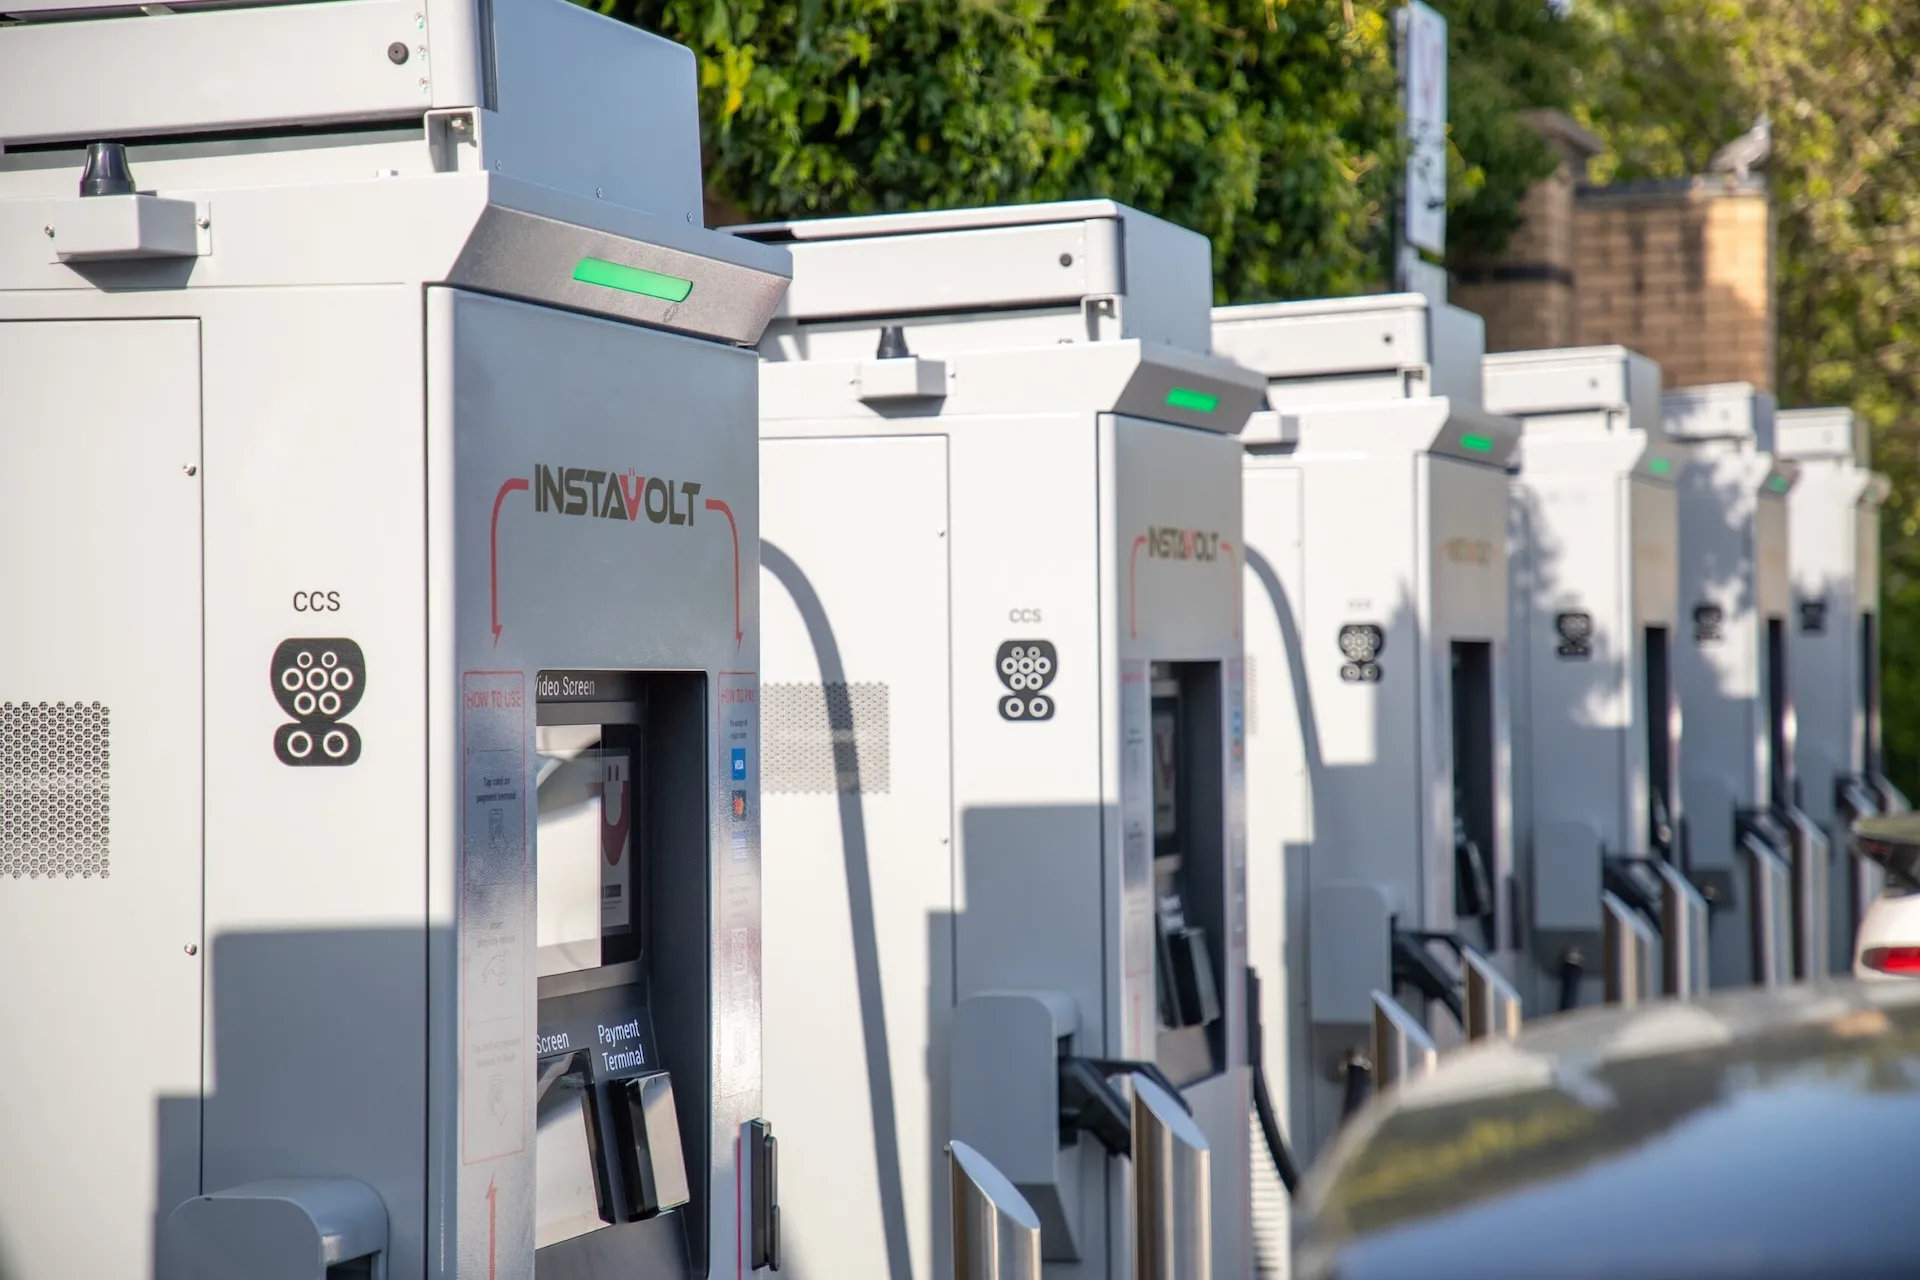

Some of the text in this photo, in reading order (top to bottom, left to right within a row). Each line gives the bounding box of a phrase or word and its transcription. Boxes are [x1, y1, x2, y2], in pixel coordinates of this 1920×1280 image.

[535, 464, 701, 526] INSTAVOLT
[1147, 525, 1219, 562] INSTAVOLT
[293, 591, 341, 612] CCS
[1009, 608, 1042, 623] CCS
[562, 676, 595, 696] Screen
[466, 690, 521, 708] HOW TO USE
[536, 1032, 570, 1054] Screen
[597, 1019, 641, 1047] Payment
[602, 1044, 645, 1072] Terminal
